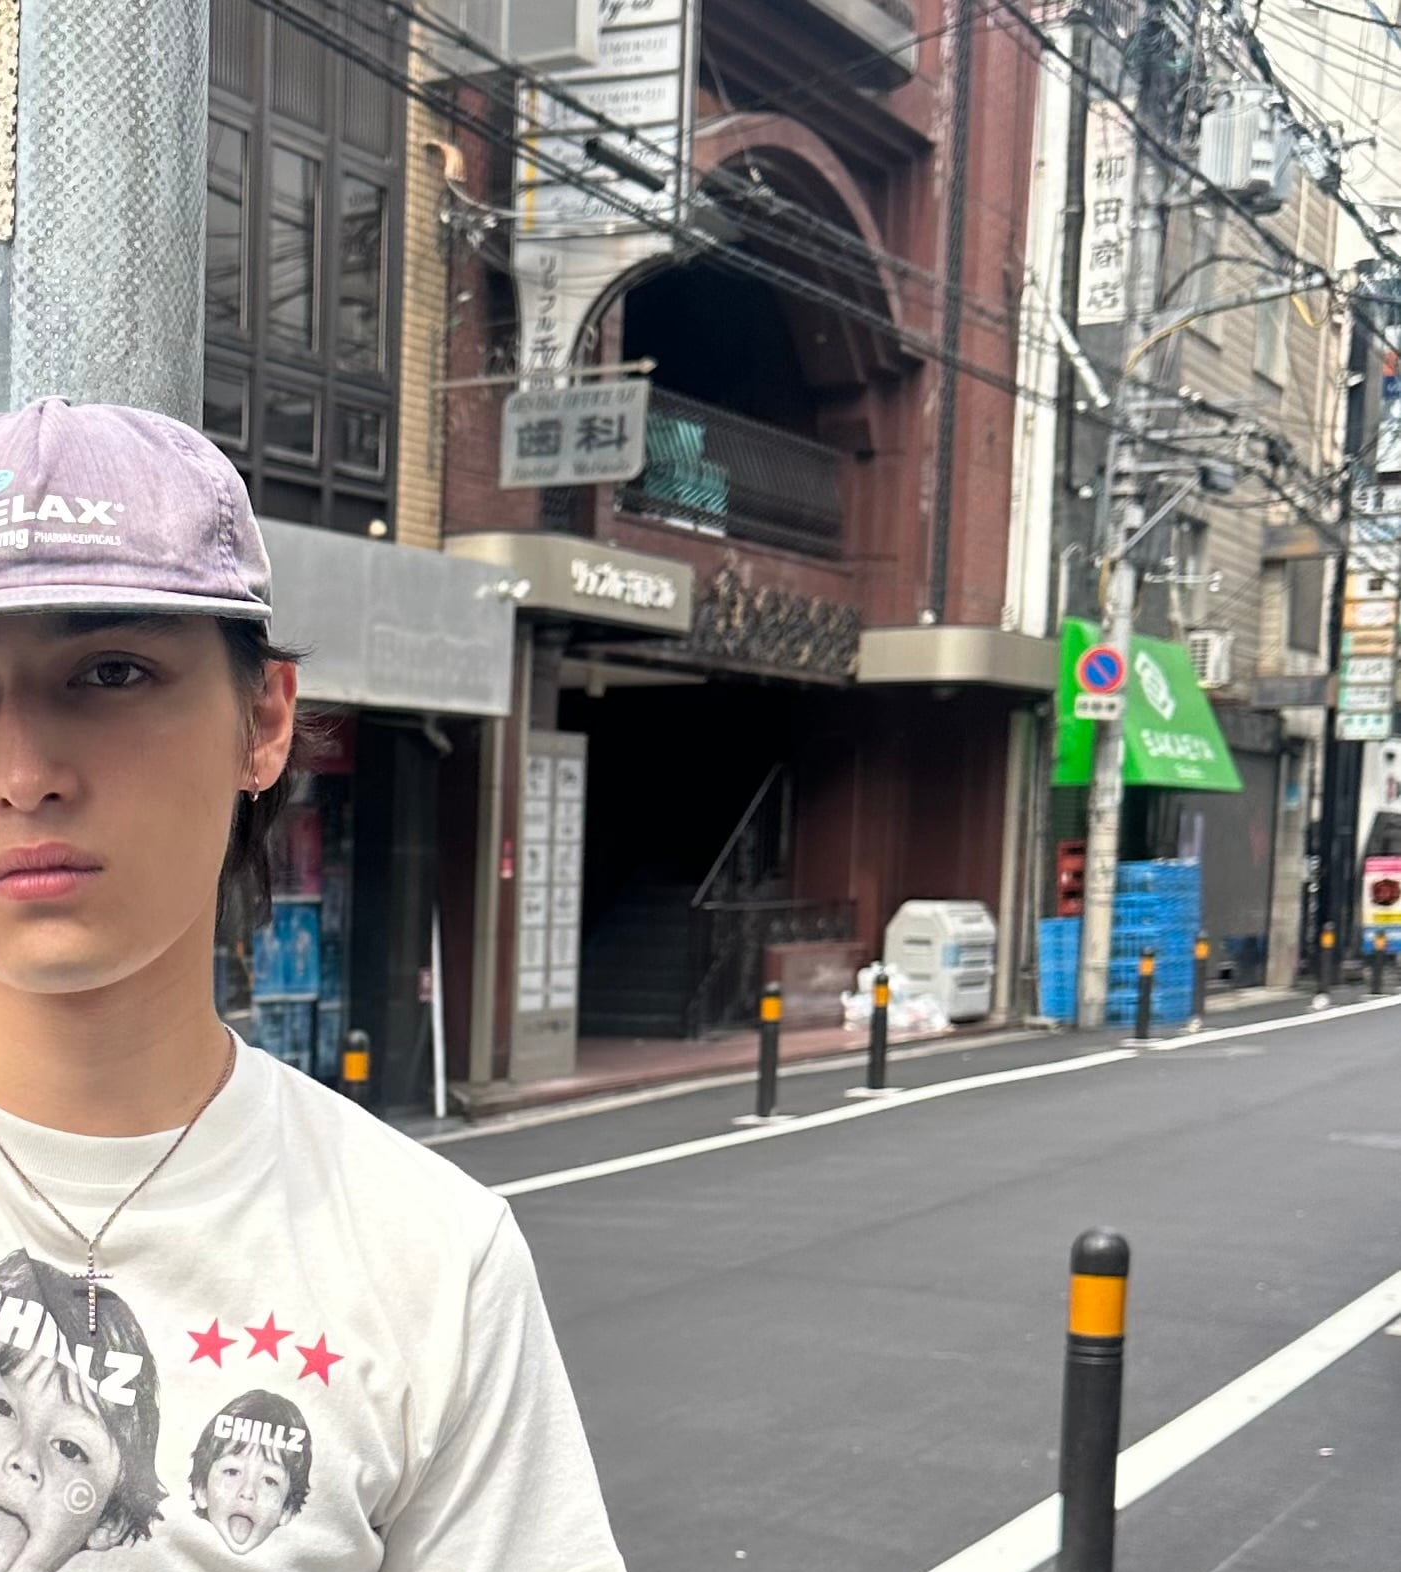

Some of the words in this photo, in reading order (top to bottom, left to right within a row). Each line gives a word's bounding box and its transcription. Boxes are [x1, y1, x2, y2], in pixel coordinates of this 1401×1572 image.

[516, 413, 628, 458] 歯科
[34, 532, 122, 546] PHARMACEUTICALS
[214, 1414, 307, 1453] CHILLZ
